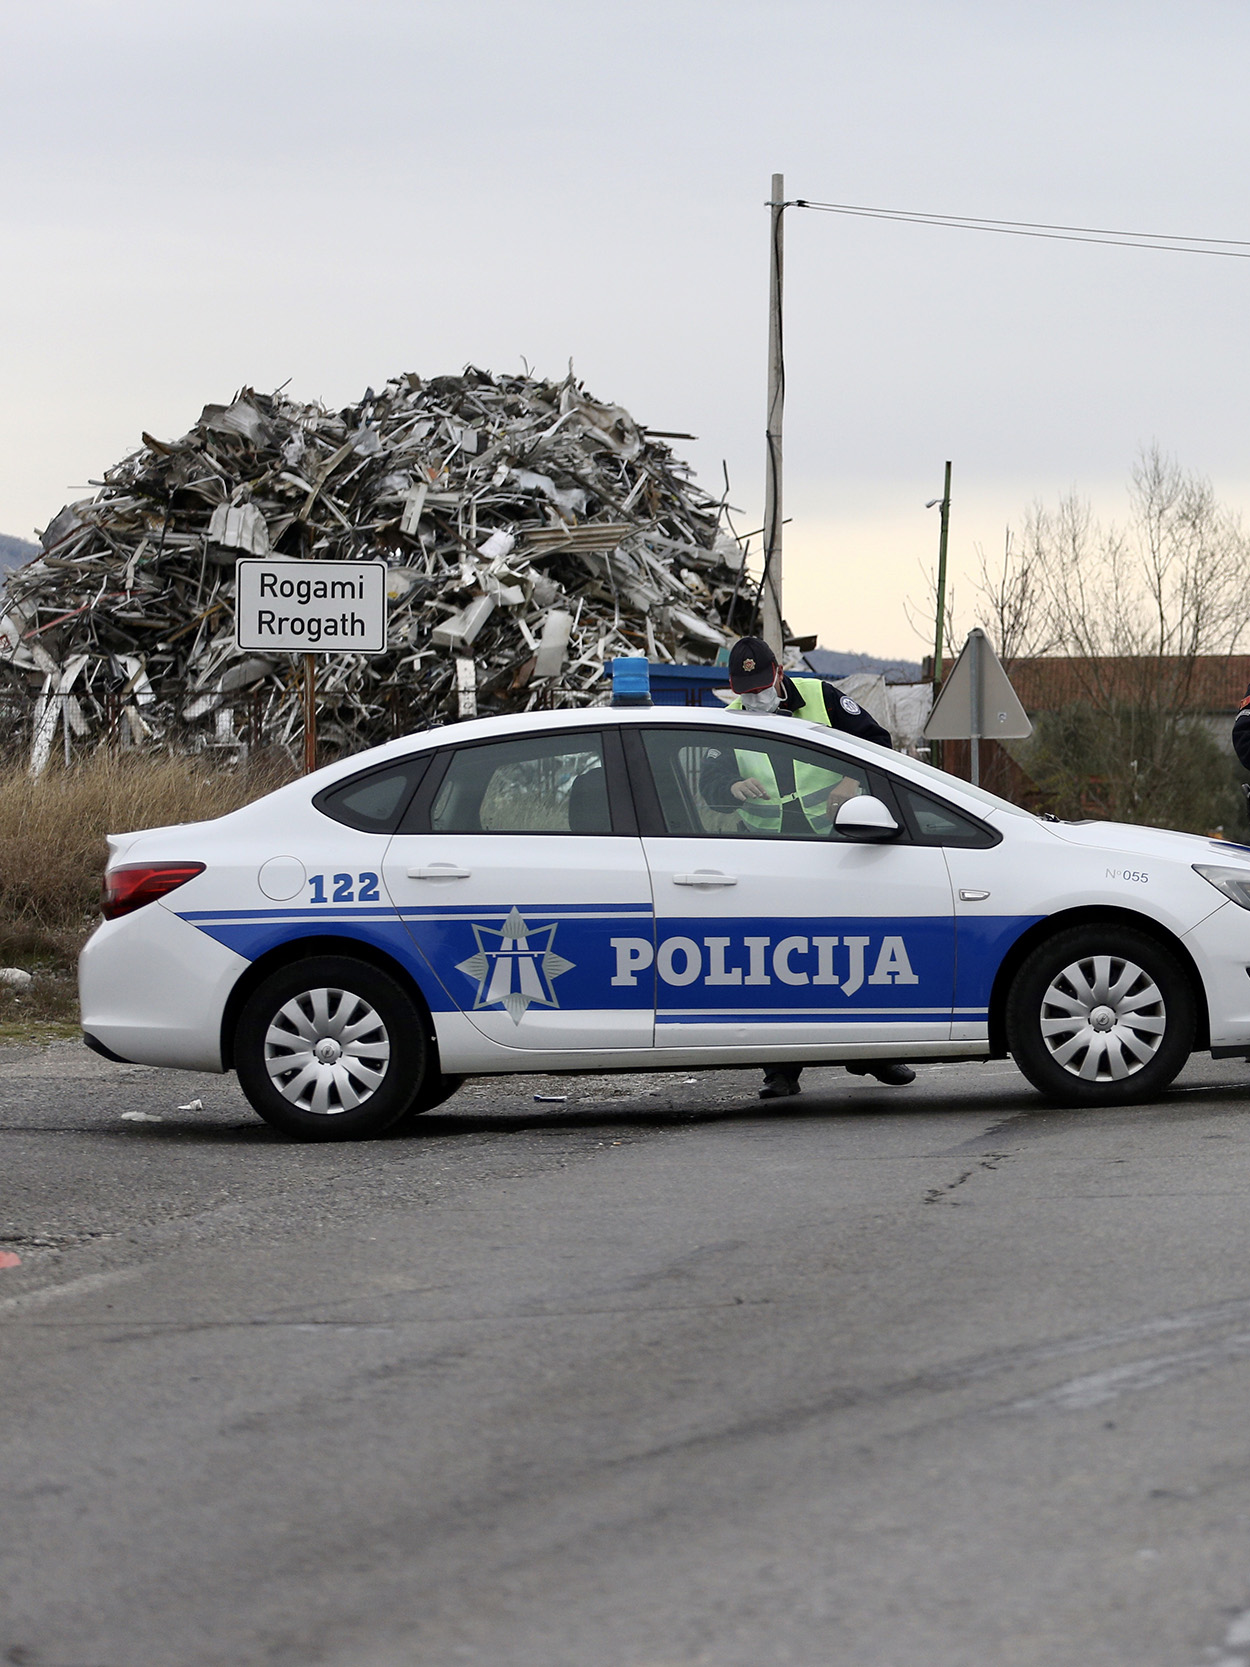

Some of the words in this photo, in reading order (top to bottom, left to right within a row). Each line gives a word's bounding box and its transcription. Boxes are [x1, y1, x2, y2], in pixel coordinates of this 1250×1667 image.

[260, 573, 364, 605] Rogami
[258, 610, 365, 642] Rrogath
[308, 871, 381, 903] 122
[610, 935, 919, 997] POLICIJA
